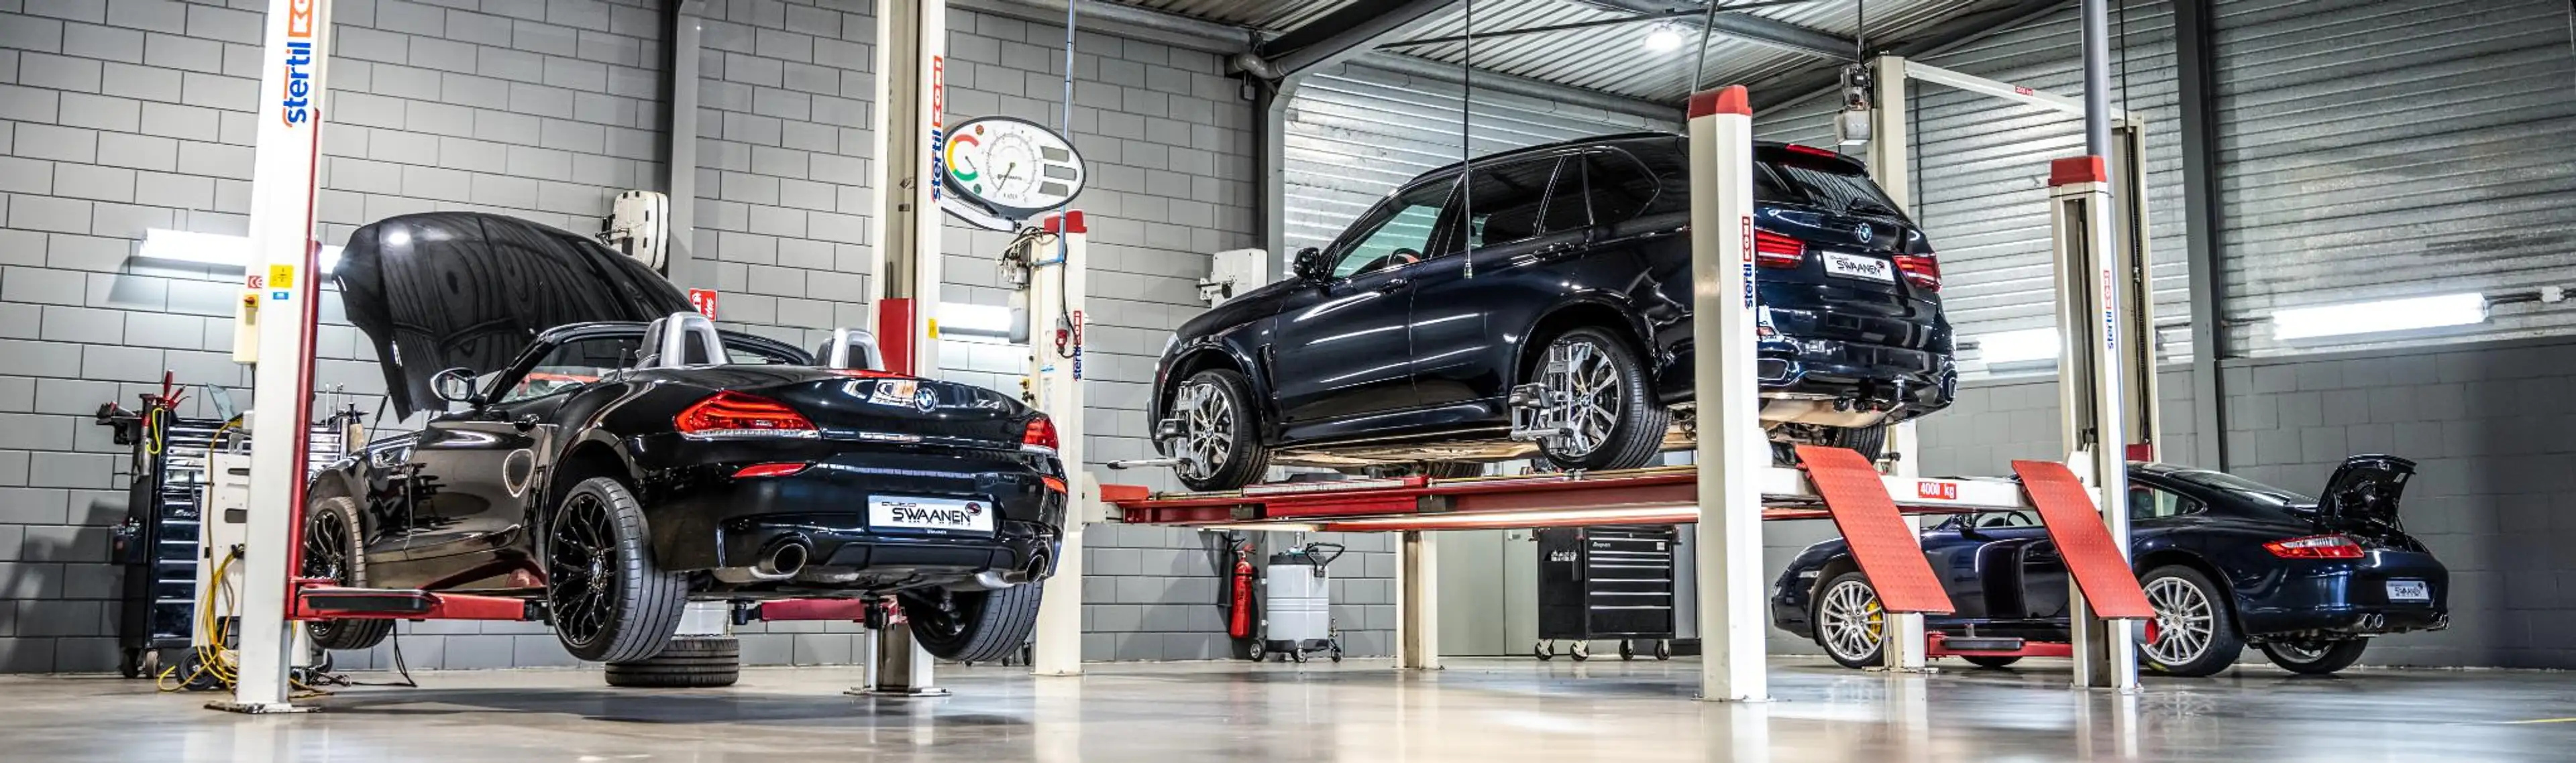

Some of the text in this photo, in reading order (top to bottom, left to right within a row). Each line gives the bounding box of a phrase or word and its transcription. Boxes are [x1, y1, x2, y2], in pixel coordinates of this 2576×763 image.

[282, 42, 311, 125] stertil
[932, 58, 943, 201] stertil KONI
[1743, 217, 1753, 308] stertil KONI
[892, 508, 971, 522] SWAANEN
[1920, 483, 1954, 498] 4000 kg
